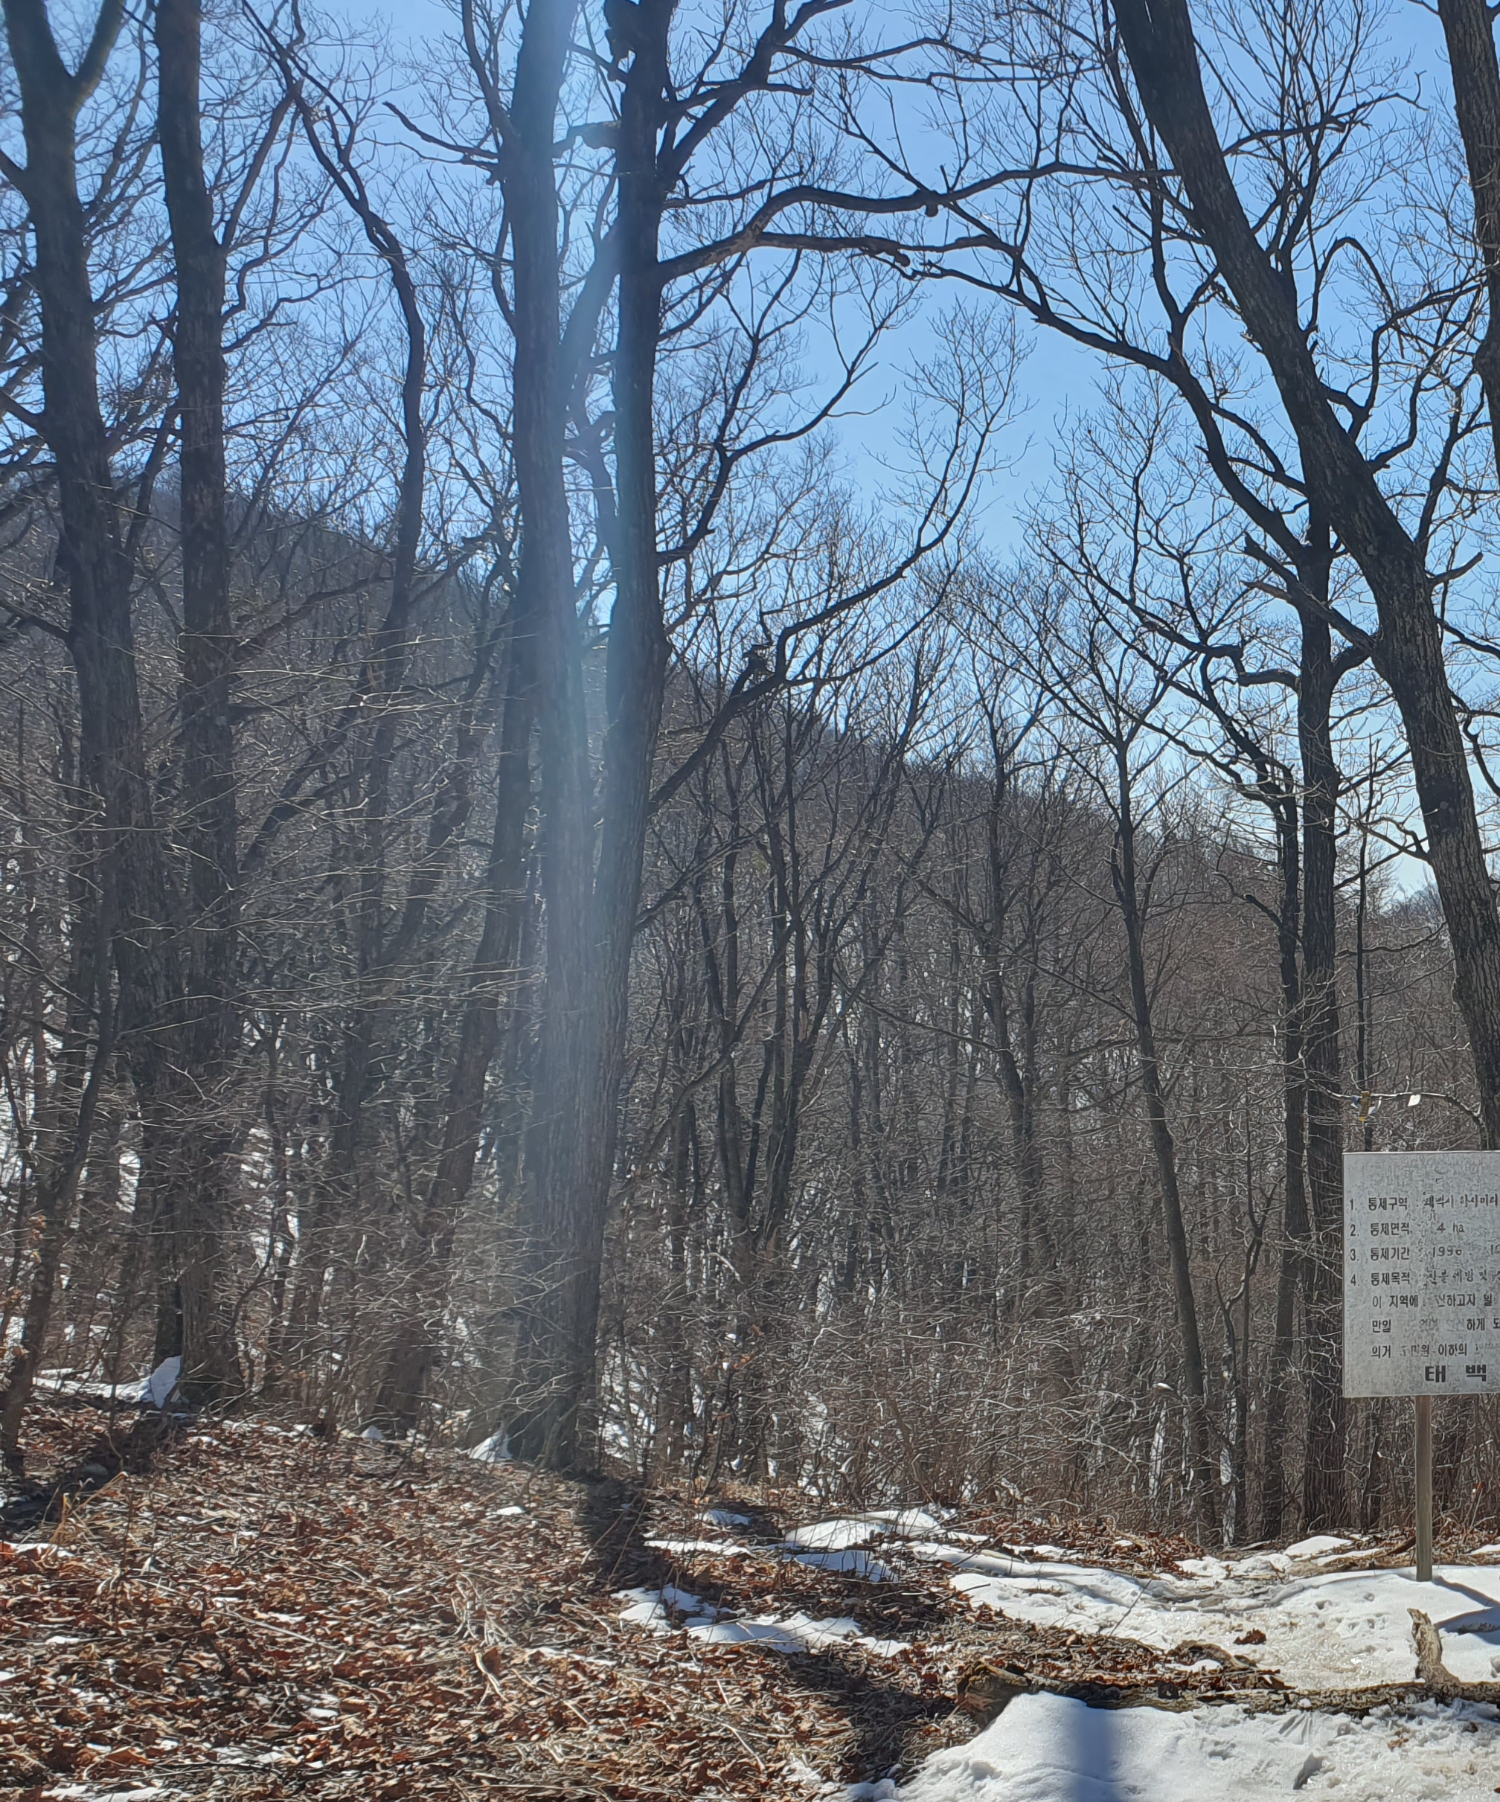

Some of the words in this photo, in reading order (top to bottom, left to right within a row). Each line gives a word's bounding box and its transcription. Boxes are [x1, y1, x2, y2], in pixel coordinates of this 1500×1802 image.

[1368, 1197, 1408, 1211] 통제구역
[1370, 1222, 1410, 1236] 통제면적
[1370, 1246, 1410, 1260] 통제기간
[1371, 1271, 1410, 1286] 통제목적
[1389, 1294, 1419, 1308] 지역에
[1372, 1319, 1392, 1333] 만일
[1371, 1344, 1392, 1358] 의거
